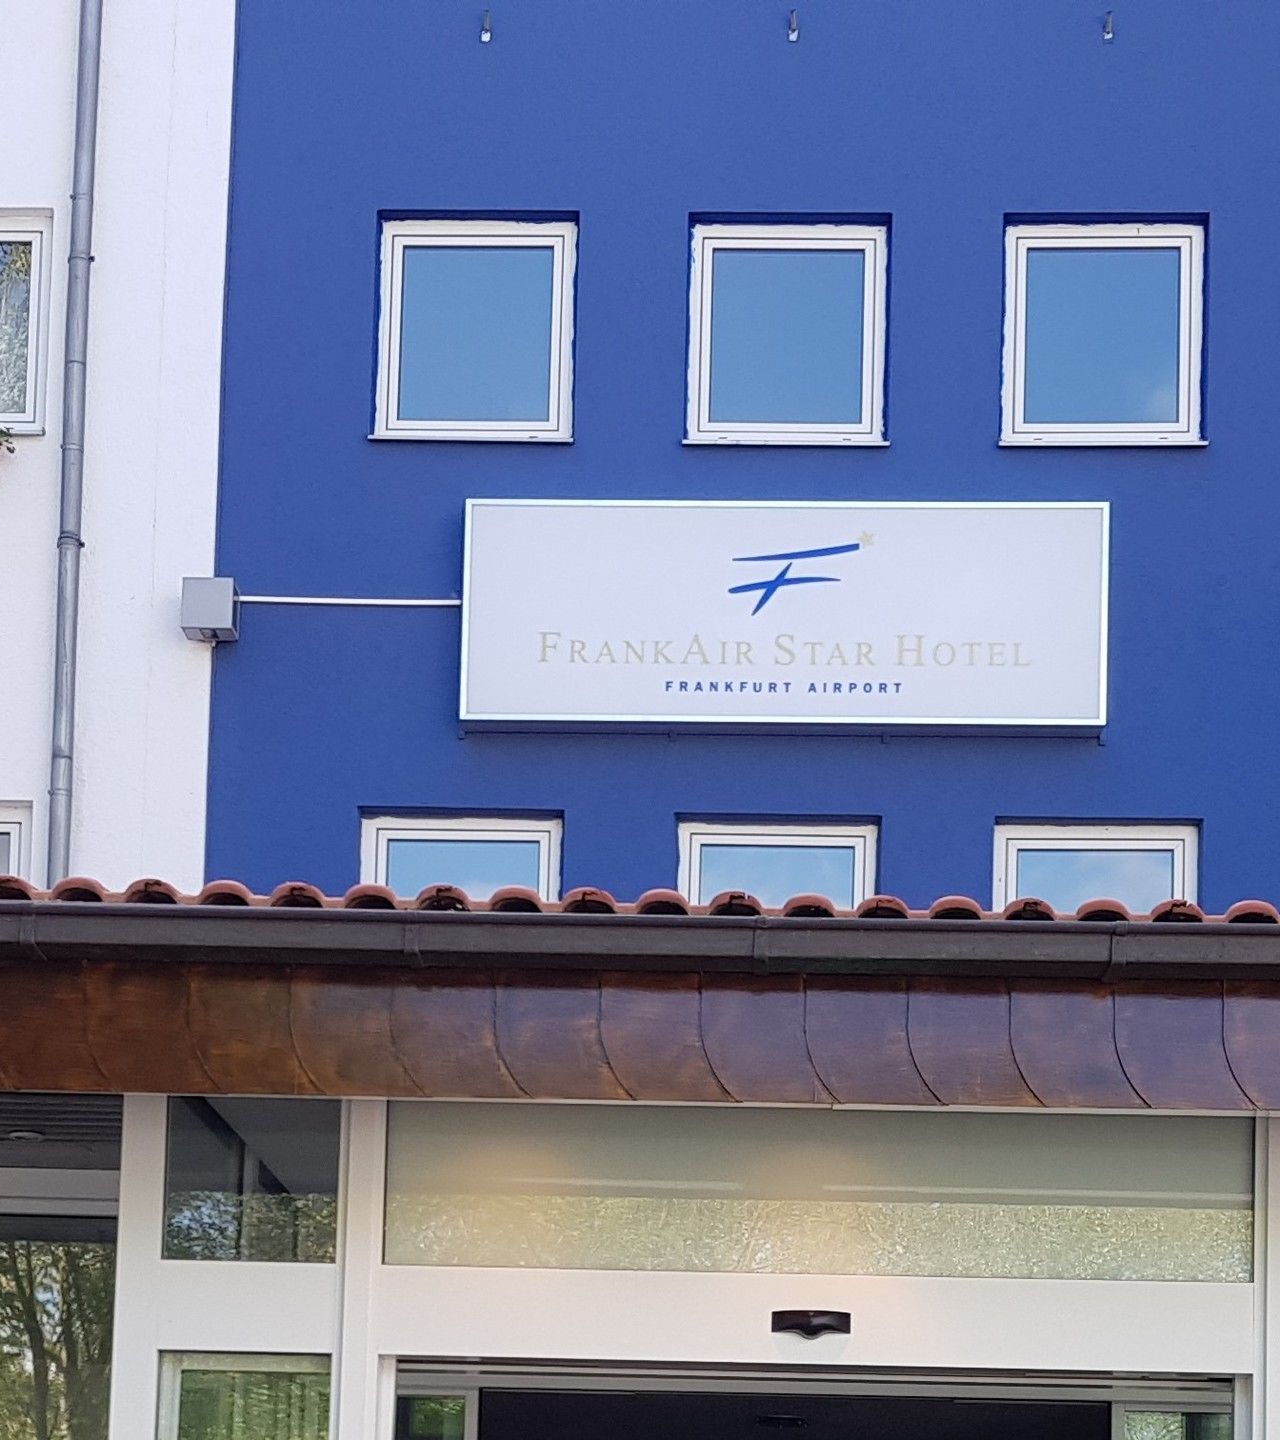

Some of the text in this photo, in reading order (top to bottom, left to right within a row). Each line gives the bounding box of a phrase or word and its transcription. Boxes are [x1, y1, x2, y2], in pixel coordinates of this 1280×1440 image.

[537, 631, 1032, 667] FRANKAIR STAR HOTEL
[665, 680, 903, 695] FRANKFURT AIRPORT
